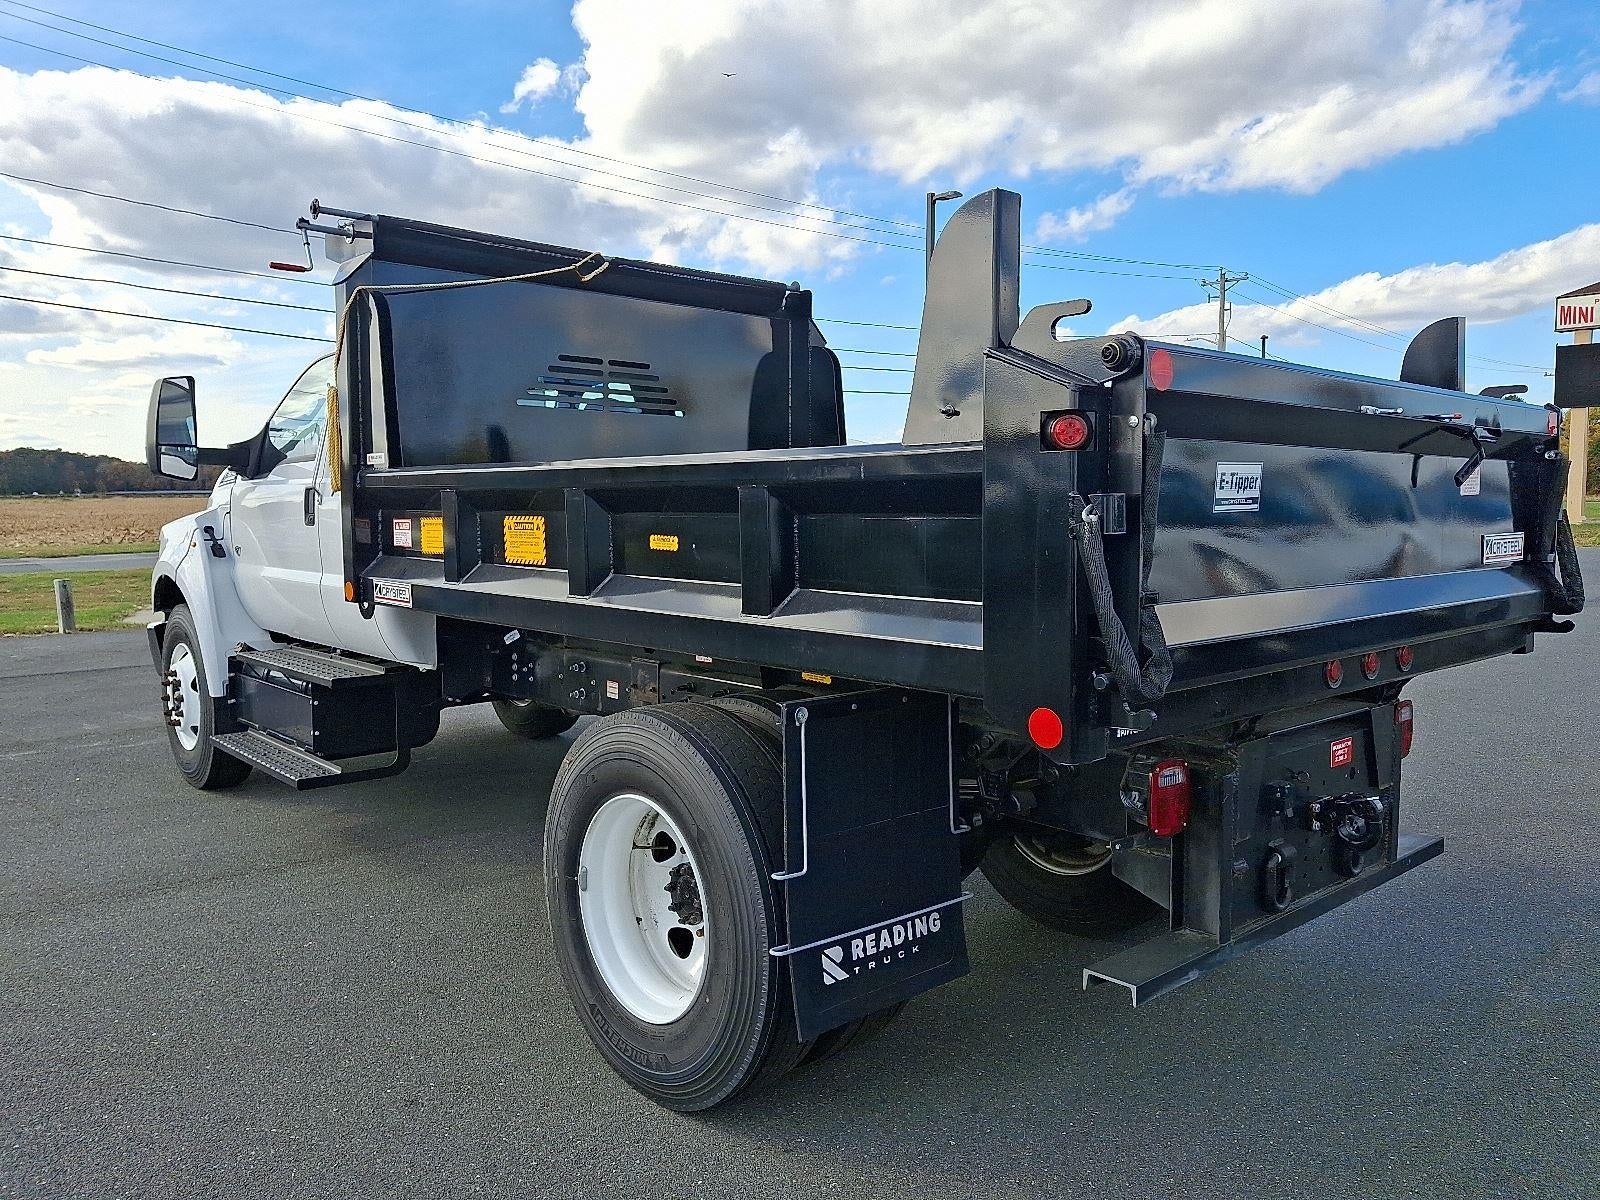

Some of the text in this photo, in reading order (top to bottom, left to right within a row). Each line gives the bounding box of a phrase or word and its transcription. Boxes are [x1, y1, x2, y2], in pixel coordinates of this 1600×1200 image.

[1559, 305, 1594, 326] MINI
[1219, 472, 1259, 495] E-Tipper
[514, 521, 534, 531] CAUTION
[1492, 540, 1521, 555] CRYSTEEL
[382, 585, 410, 601] CRYSTEEL
[851, 912, 942, 961] READING
[853, 944, 920, 975] TRUCK
